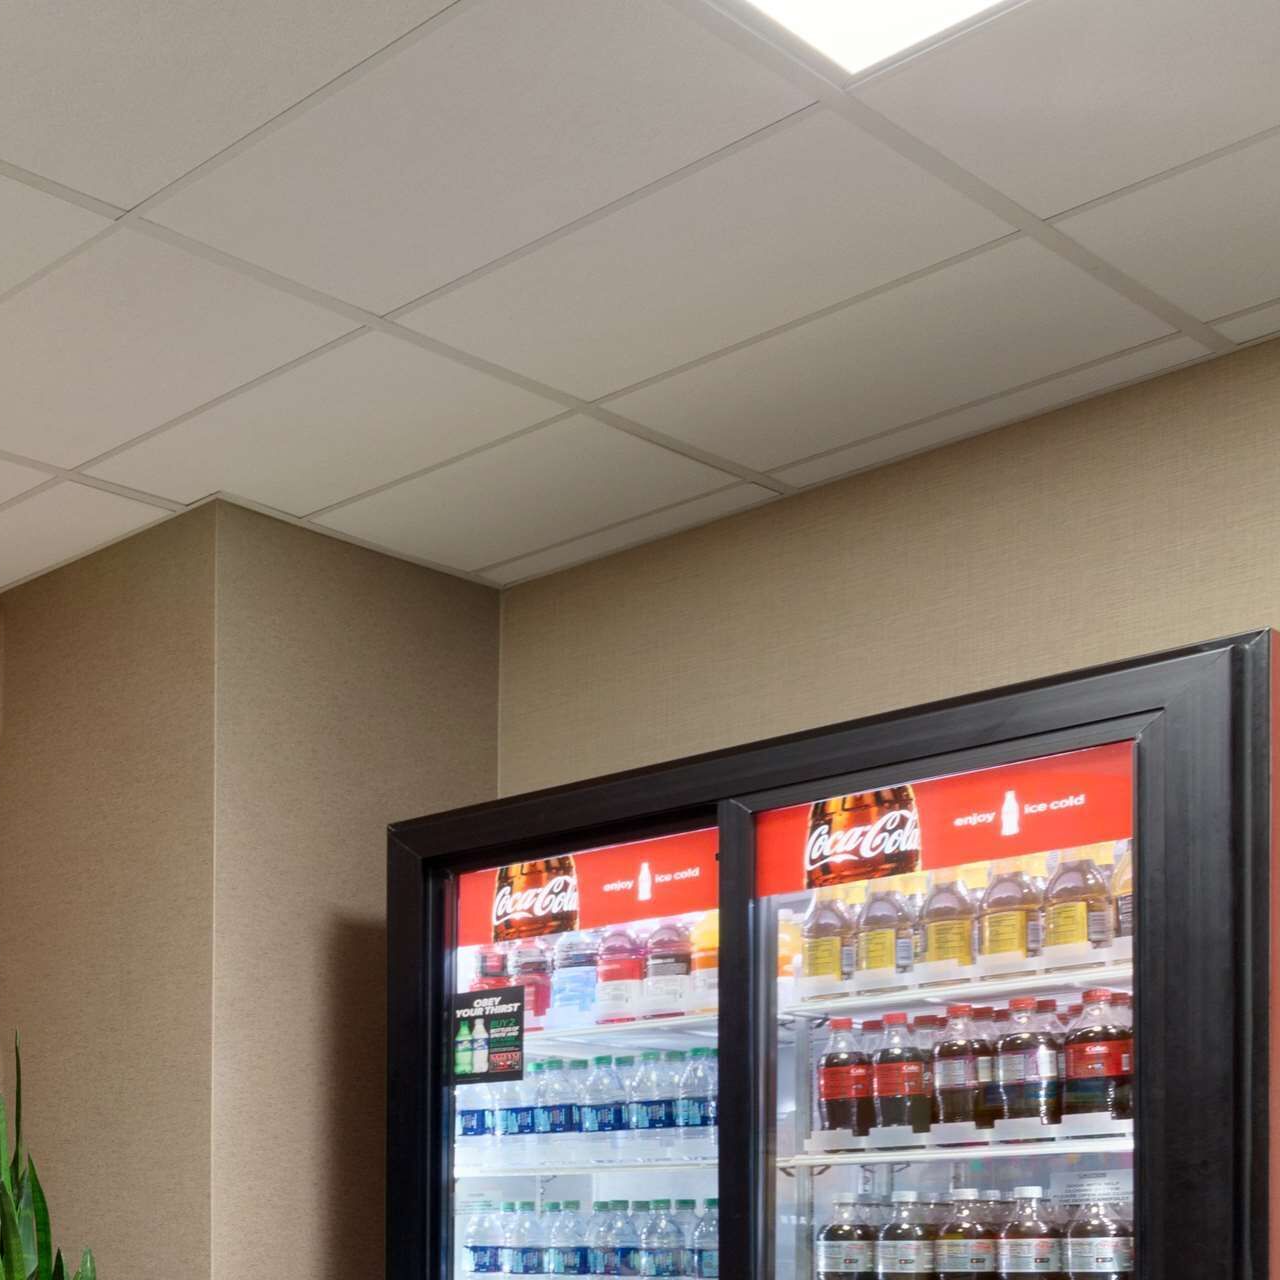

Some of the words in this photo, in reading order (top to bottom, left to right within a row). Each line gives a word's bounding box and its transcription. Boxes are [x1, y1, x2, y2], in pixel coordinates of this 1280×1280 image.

[953, 811, 995, 827] enjoy
[1024, 803, 1047, 815] ice
[1048, 794, 1085, 811] cold
[603, 879, 634, 892] enjoy
[655, 873, 672, 884] ice
[673, 866, 700, 879] cold
[456, 1007, 484, 1018] YOUR
[485, 1002, 521, 1016] THIRST
[473, 996, 502, 1008] OBEY
